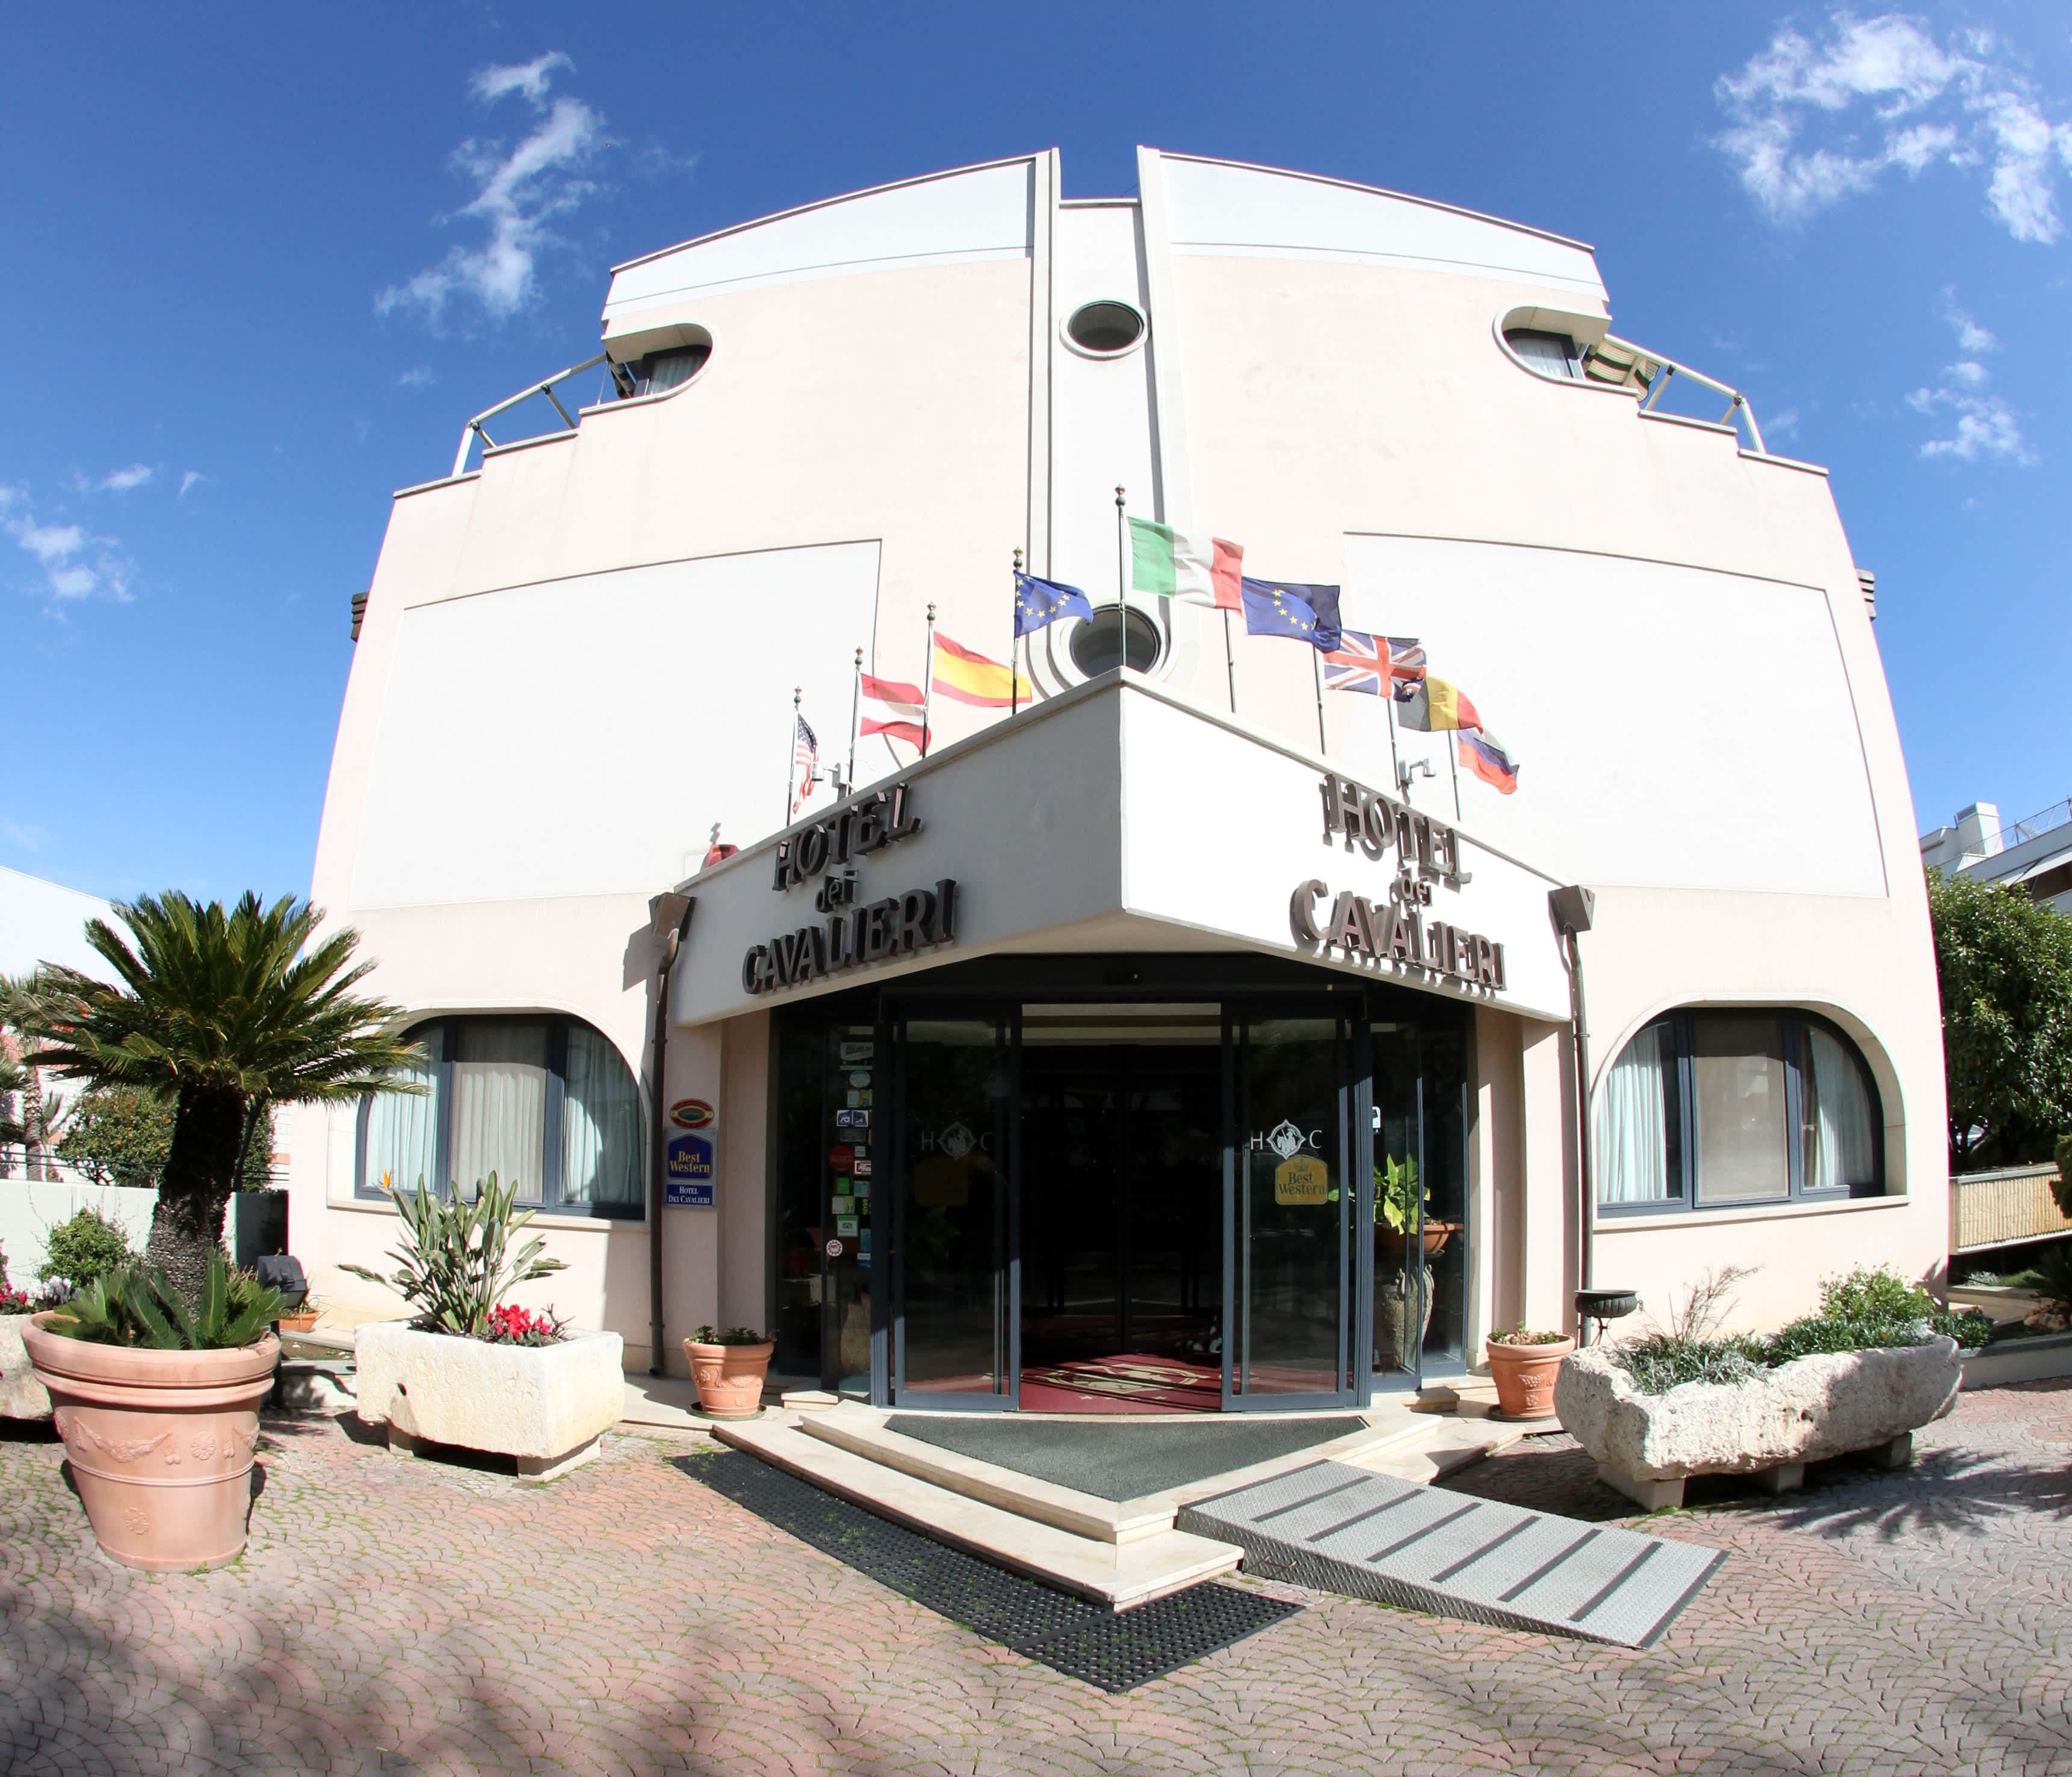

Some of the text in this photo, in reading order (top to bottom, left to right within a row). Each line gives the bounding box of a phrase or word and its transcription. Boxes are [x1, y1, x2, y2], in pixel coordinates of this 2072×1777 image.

[772, 782, 923, 891] HOTEL
[1321, 774, 1472, 888] HOTEL
[815, 870, 859, 913] dei
[742, 879, 959, 995] CAVALIERI
[1292, 879, 1508, 992] CAVALIERI
[1251, 1130, 1322, 1150] H C
[670, 1160, 710, 1173] Western
[678, 1151, 700, 1163] Best
[1279, 1183, 1325, 1195] Western
[1288, 1172, 1313, 1185] Best
